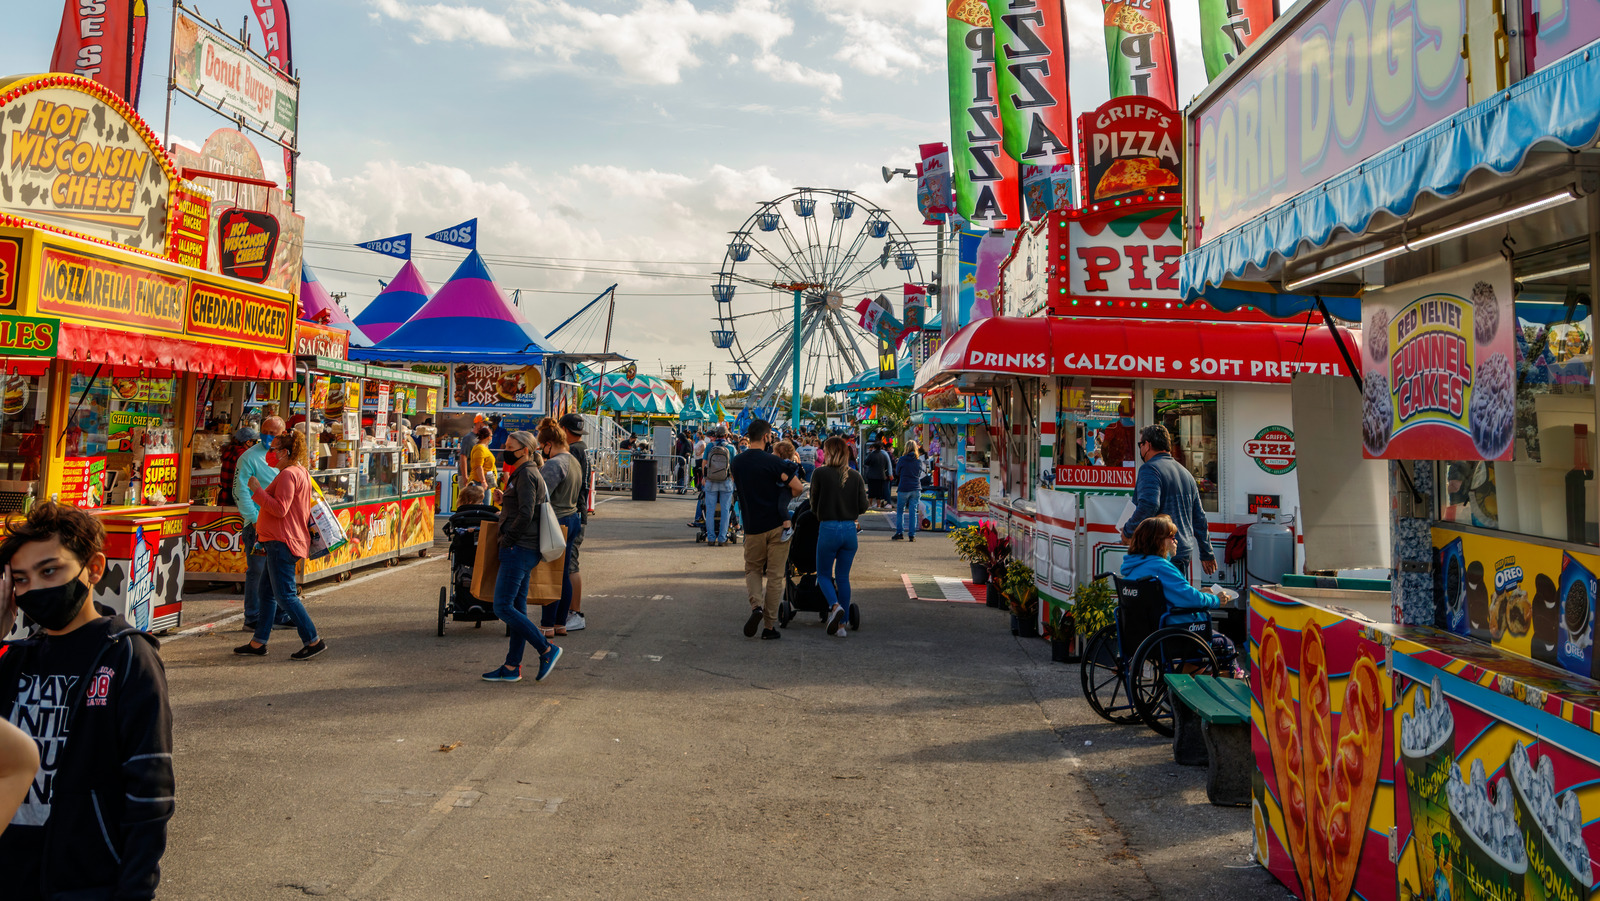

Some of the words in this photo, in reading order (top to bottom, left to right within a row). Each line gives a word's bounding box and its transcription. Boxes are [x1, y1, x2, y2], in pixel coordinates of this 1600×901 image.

[205, 43, 242, 92] Donut
[244, 64, 274, 114] Burger
[29, 99, 88, 137] HOT
[1096, 104, 1171, 129] GRIFF'S
[1093, 131, 1180, 166] PIZZA
[1201, 58, 1288, 226] CORN
[10, 129, 150, 182] WISCONSIN
[51, 172, 138, 212] CHEESE
[230, 222, 249, 237] HOT
[435, 226, 472, 243] GYROS
[224, 232, 270, 254] WISCONSIN
[367, 240, 406, 254] GYROS
[235, 246, 265, 264] CHEESE
[42, 257, 132, 314] MOZZARELLA
[134, 277, 184, 323] FINGERS
[191, 289, 243, 333] CHEDDAR
[243, 300, 287, 340] NUGGETS
[1398, 308, 1417, 345] RED
[1420, 301, 1462, 332] VELVET
[299, 337, 344, 360] SAUSAGE
[969, 350, 1047, 369] DRINKS
[1063, 352, 1166, 373] CALZONE
[1189, 357, 1243, 376] SOFT
[1391, 331, 1472, 394] FUNNEL
[468, 364, 502, 378] SHISH
[468, 391, 500, 406] BOBS
[1398, 371, 1464, 422] CAKES
[112, 413, 131, 425] CHILI
[1248, 443, 1296, 455] PIZZ
[150, 459, 162, 467] MAKE
[169, 458, 174, 466] A
[144, 466, 177, 484] SUPER
[1058, 468, 1073, 482] ICE
[1074, 468, 1099, 484] COLD
[1100, 469, 1133, 485] DRINKS
[1256, 495, 1272, 505] NO
[163, 519, 183, 536] FINGERS
[1495, 566, 1523, 588] OREO
[1589, 579, 1597, 594] 10
[1122, 586, 1138, 597] drive
[1189, 623, 1206, 632] drive
[1565, 641, 1585, 660] OREO
